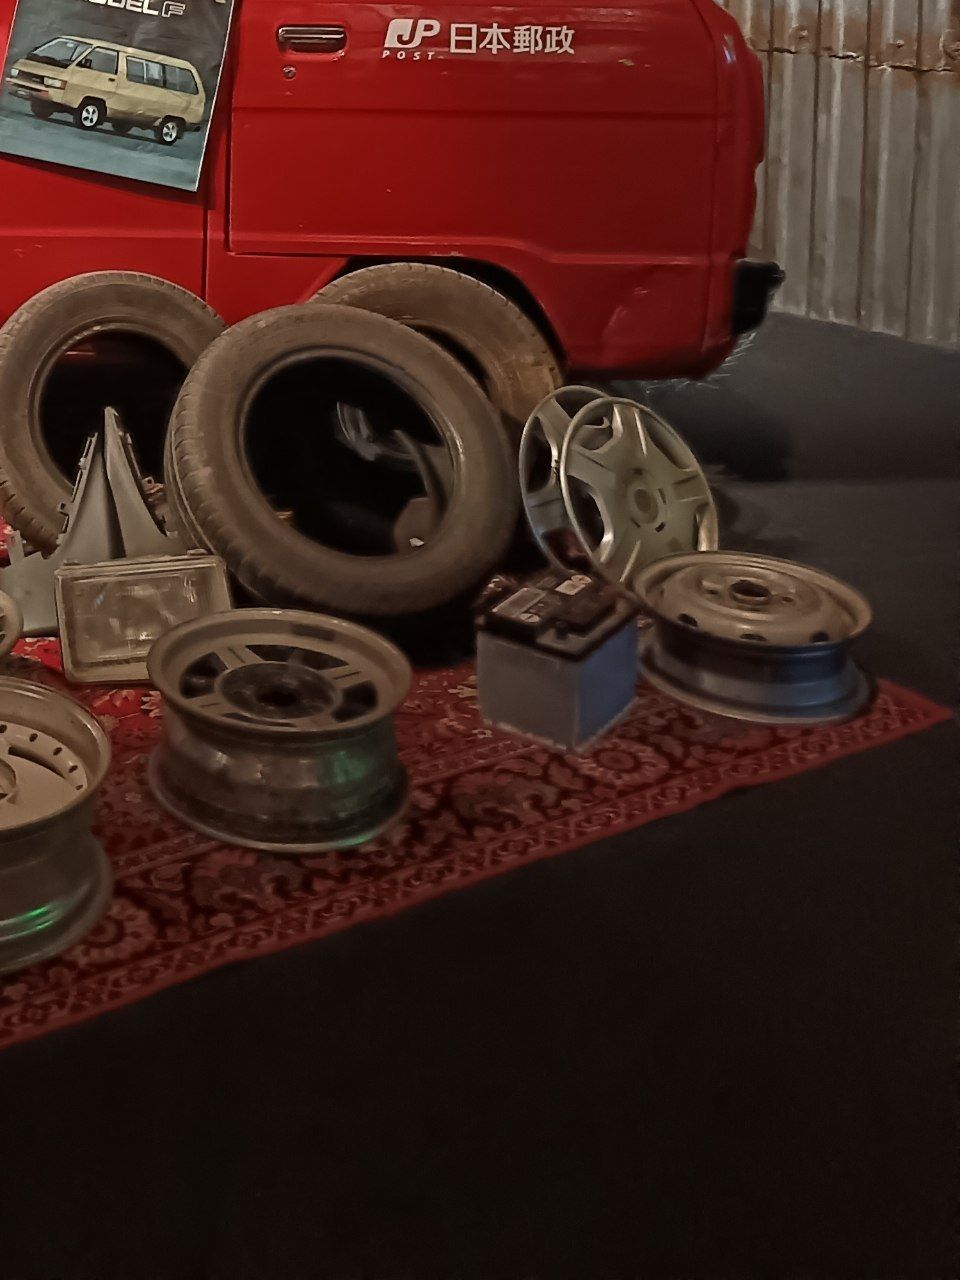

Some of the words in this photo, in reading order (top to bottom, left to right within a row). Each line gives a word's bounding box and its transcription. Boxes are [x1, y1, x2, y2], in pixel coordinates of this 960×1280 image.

[161, 0, 186, 18] F
[450, 23, 576, 55] 日本郵政
[381, 50, 436, 61] POST
